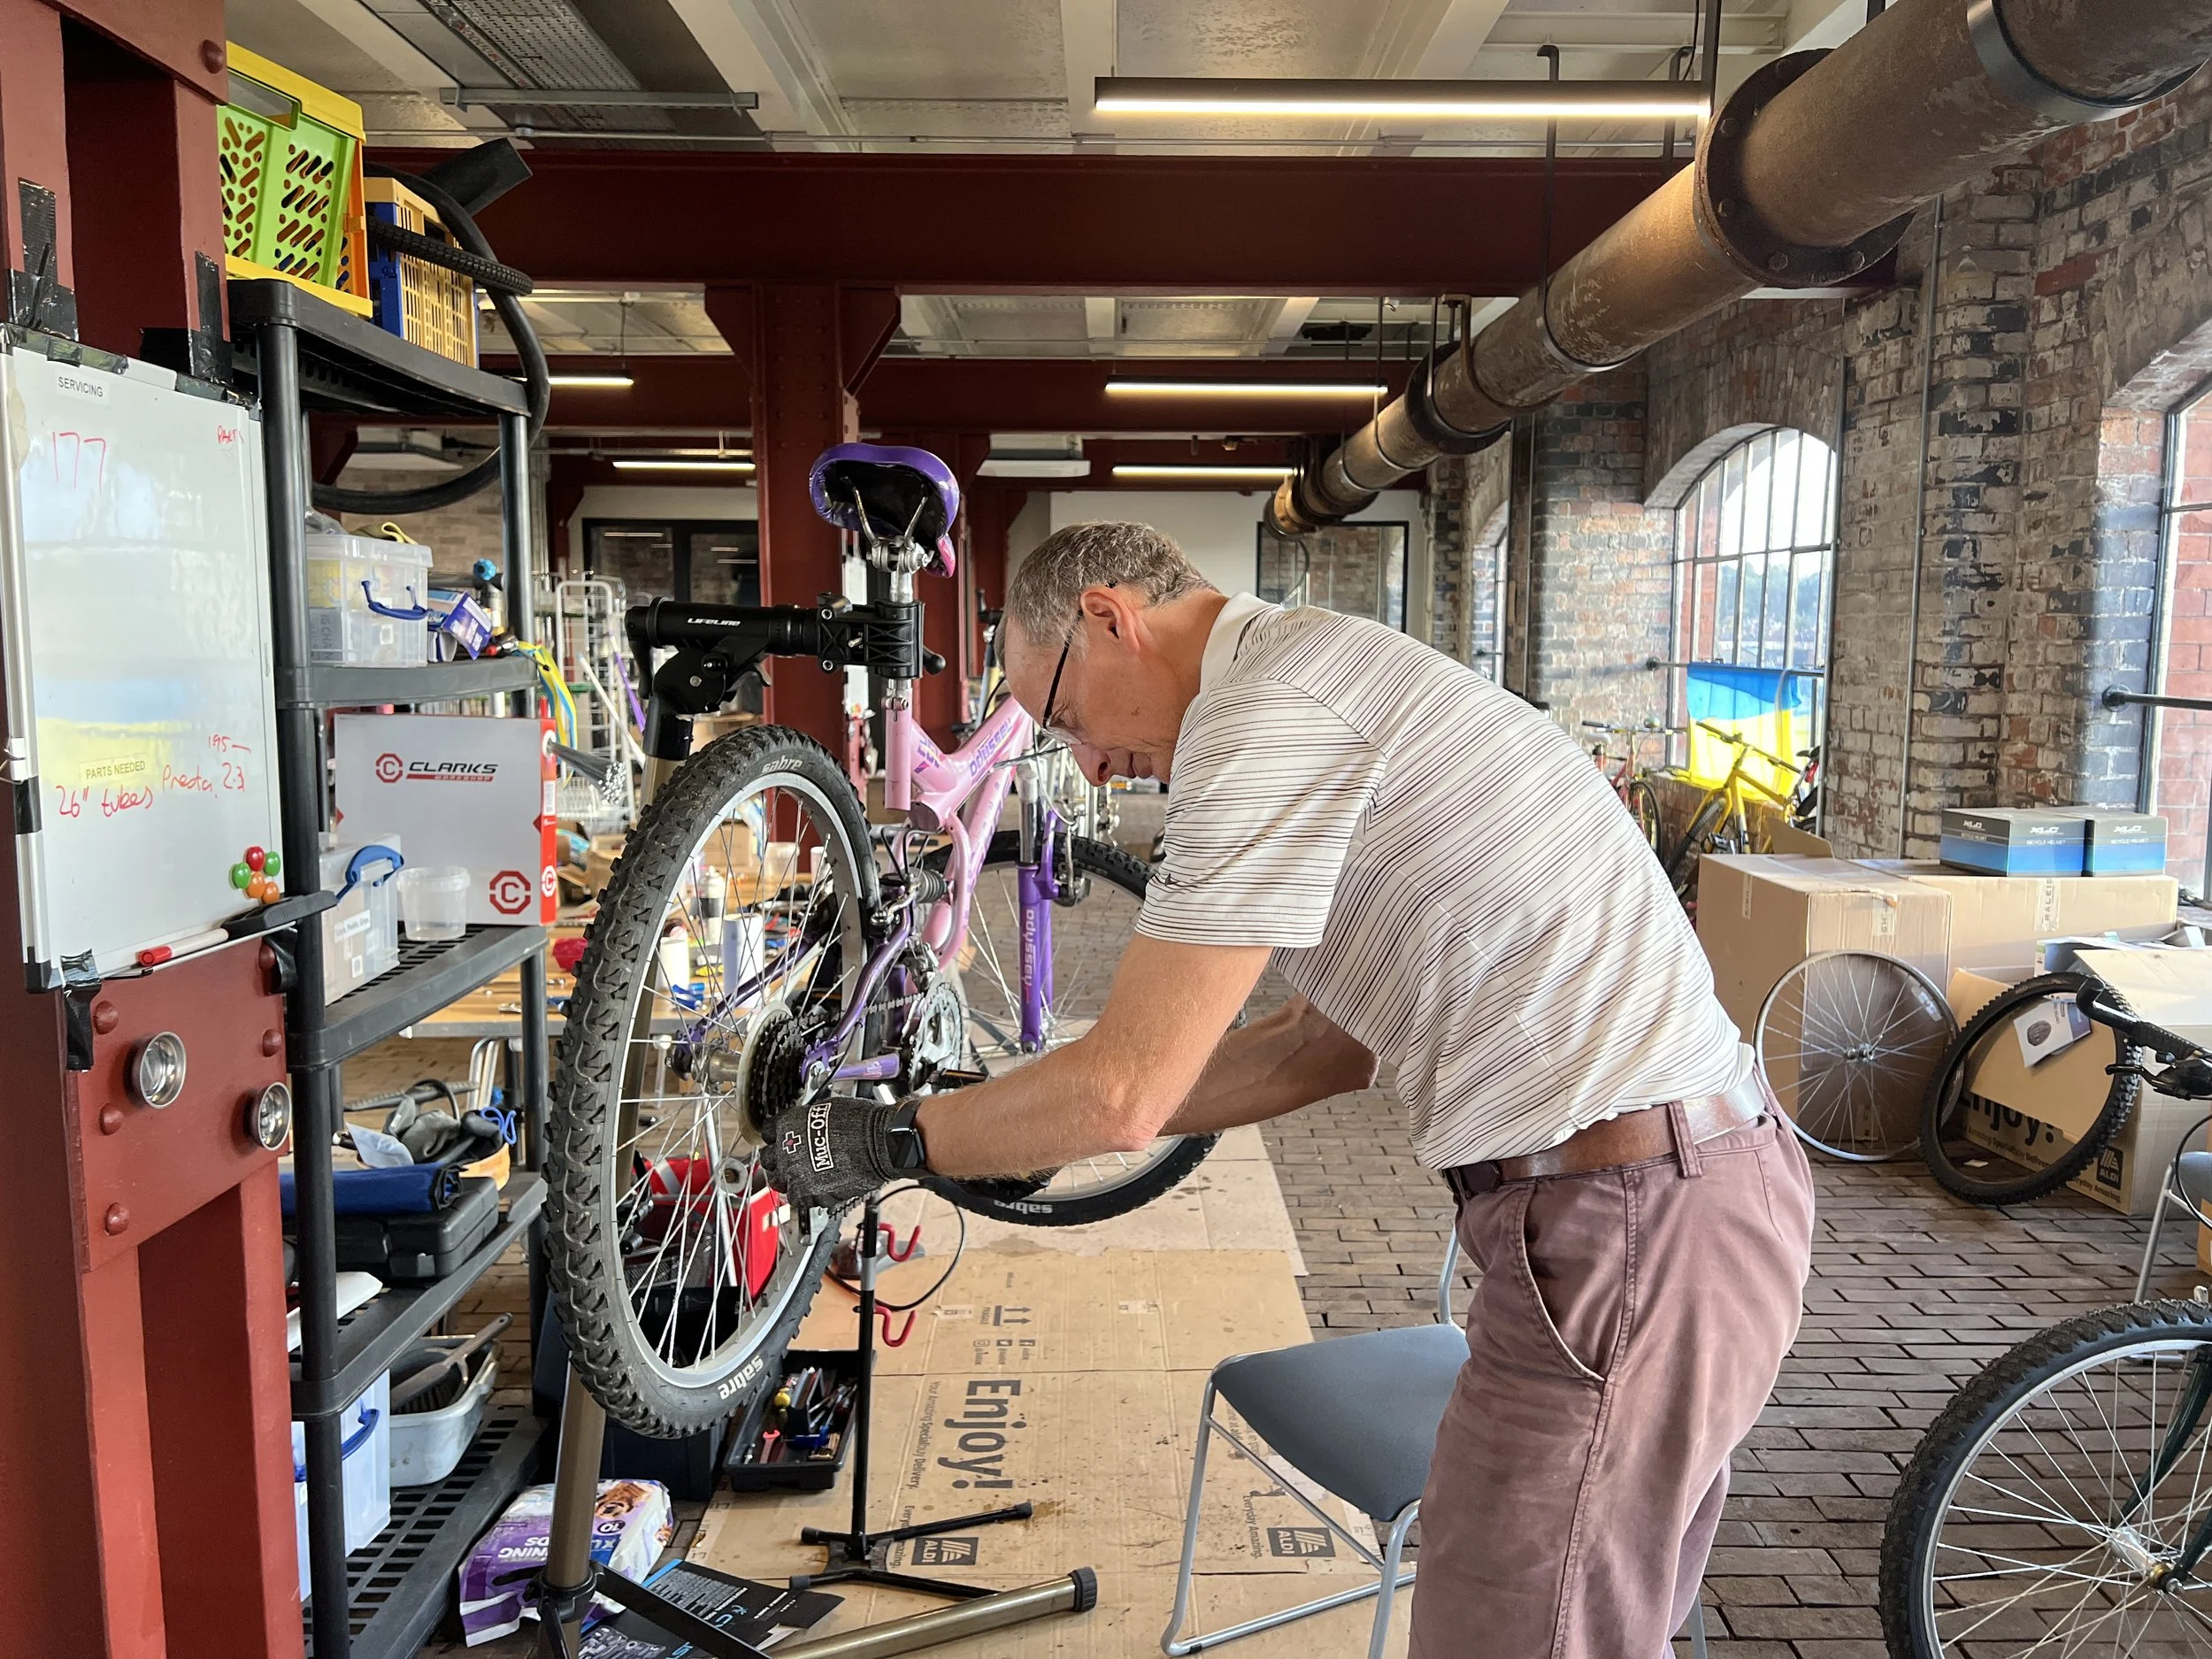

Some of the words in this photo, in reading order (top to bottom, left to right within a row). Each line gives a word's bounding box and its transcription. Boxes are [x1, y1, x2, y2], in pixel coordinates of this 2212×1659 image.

[58, 377, 104, 397] SERVICING
[52, 431, 106, 495] 177
[86, 765, 112, 780] PARTS
[113, 760, 146, 777] NEEDED
[409, 762, 498, 774] CLARKS
[761, 755, 803, 774] sabre
[102, 785, 154, 818] tubes
[810, 1105, 830, 1169] Muc-Off
[2025, 1152, 2050, 1169] Deliver
[2099, 1170, 2119, 1183] ALDI
[718, 1355, 764, 1400] sabre
[929, 1380, 941, 1394] Your
[920, 1395, 939, 1422] Amazing
[912, 1422, 933, 1458] Specialbuy
[938, 1379, 1027, 1489] Enjoy!
[905, 1458, 926, 1490] Delivery.
[899, 1505, 915, 1528] Everyd
[1242, 1495, 1257, 1529] Everyday
[603, 1522, 622, 1533] 10
[889, 1540, 907, 1569] mazing.
[922, 1540, 939, 1563] ALDI
[1247, 1528, 1263, 1560] Amazing.
[1277, 1530, 1295, 1555] ALDI
